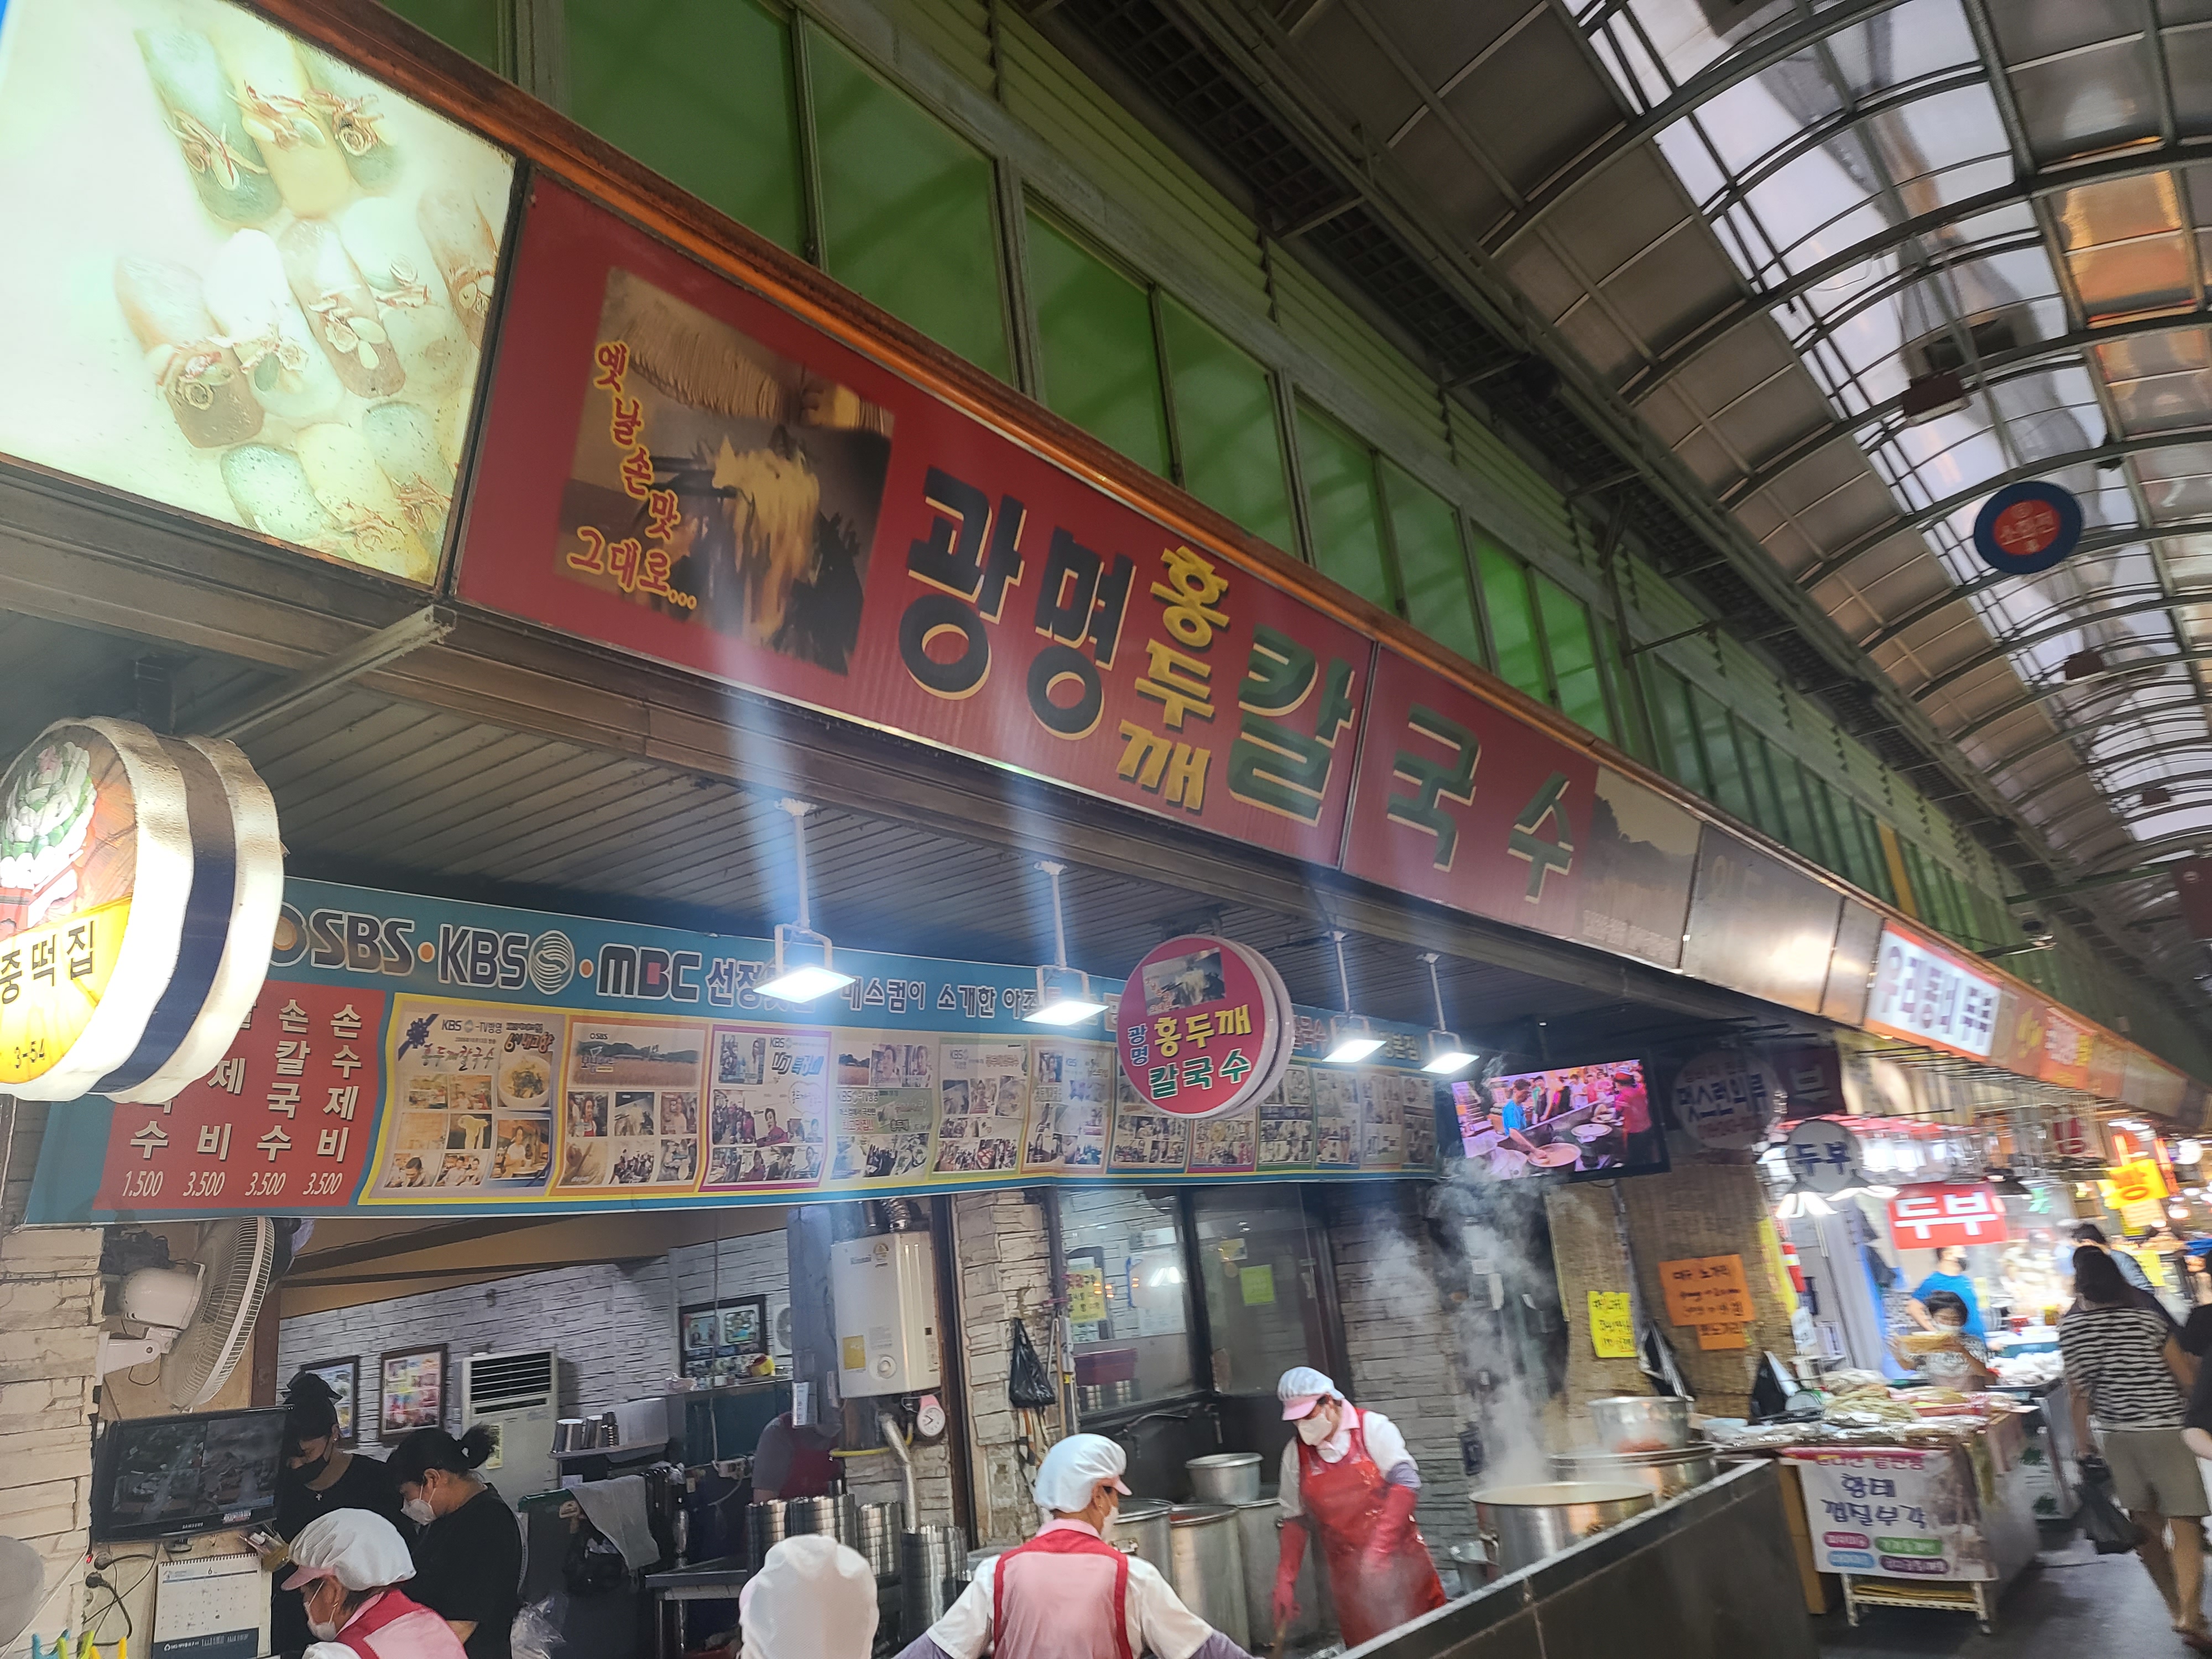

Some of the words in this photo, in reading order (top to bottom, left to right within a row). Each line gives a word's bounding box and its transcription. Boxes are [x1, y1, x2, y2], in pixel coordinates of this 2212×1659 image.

[899, 465, 1136, 741] 광명
[1115, 545, 1231, 812] 홍두깨
[1227, 622, 1575, 904] 칼국수
[310, 908, 415, 977] SBS
[437, 923, 530, 990] KBS
[595, 943, 702, 1003] MBC
[937, 983, 995, 1019] 소개한
[1127, 1022, 1149, 1067] 광명
[1153, 1004, 1253, 1058] 홍두깨
[257, 999, 311, 1161] 손칼국수
[316, 1004, 362, 1162] 손수제비
[1147, 1047, 1252, 1100] 칼국수
[1893, 1190, 1998, 1240] 두부
